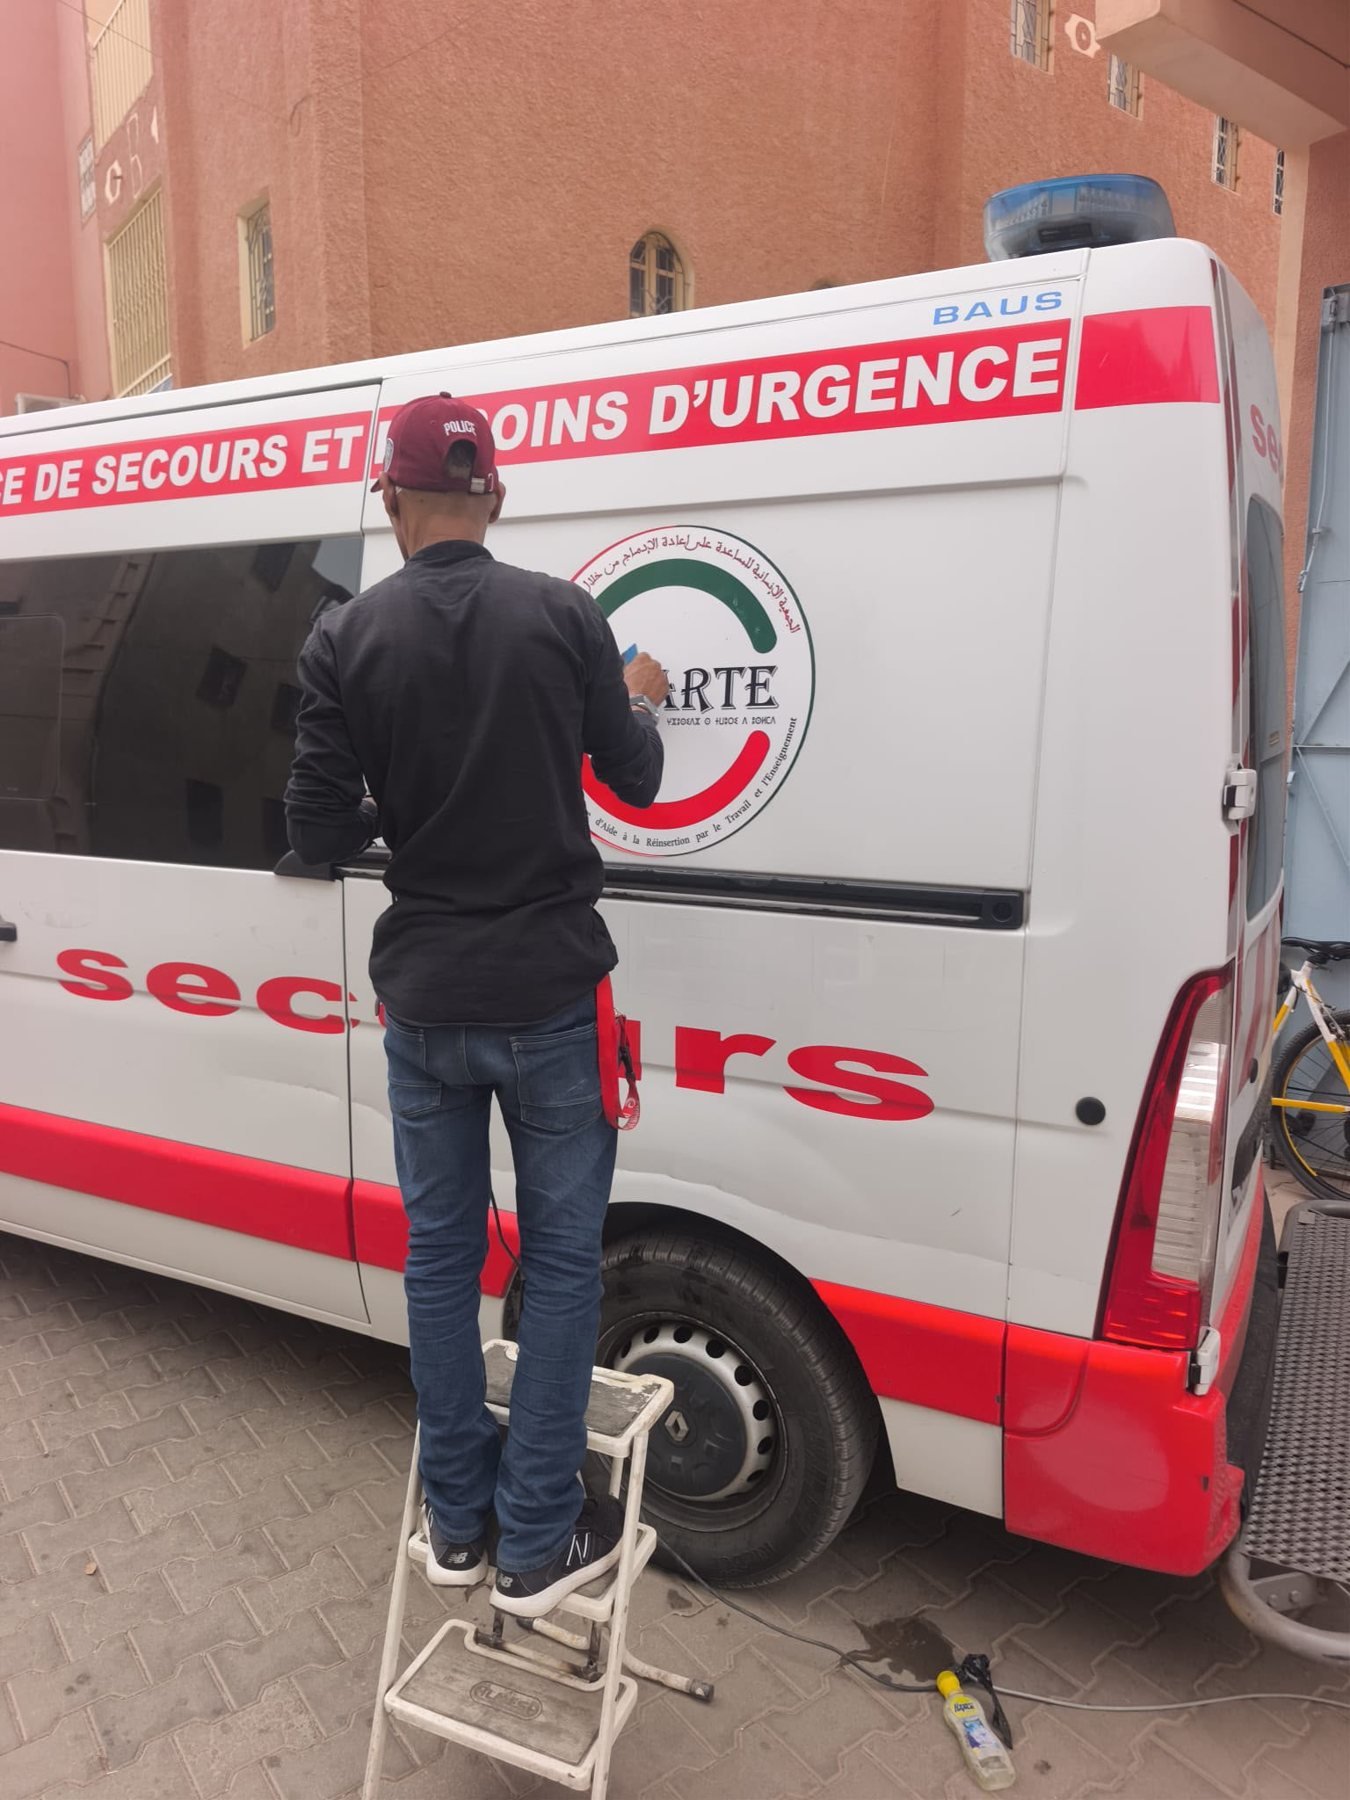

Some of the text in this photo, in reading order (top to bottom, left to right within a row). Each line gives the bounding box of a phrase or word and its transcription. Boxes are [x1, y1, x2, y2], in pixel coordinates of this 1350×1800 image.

[933, 291, 1063, 325] BAUS
[443, 420, 477, 436] POLICE
[33, 459, 83, 502] DE
[91, 435, 288, 494] SECOURS
[301, 425, 363, 474] ET
[477, 391, 628, 451] OINS
[684, 536, 712, 551] على
[716, 541, 755, 569] للمساعدة
[604, 559, 620, 575] من
[779, 597, 801, 633] الجمعية
[595, 717, 797, 847] d'Aide à la Réinsertion par le Travail et l'Enseignement
